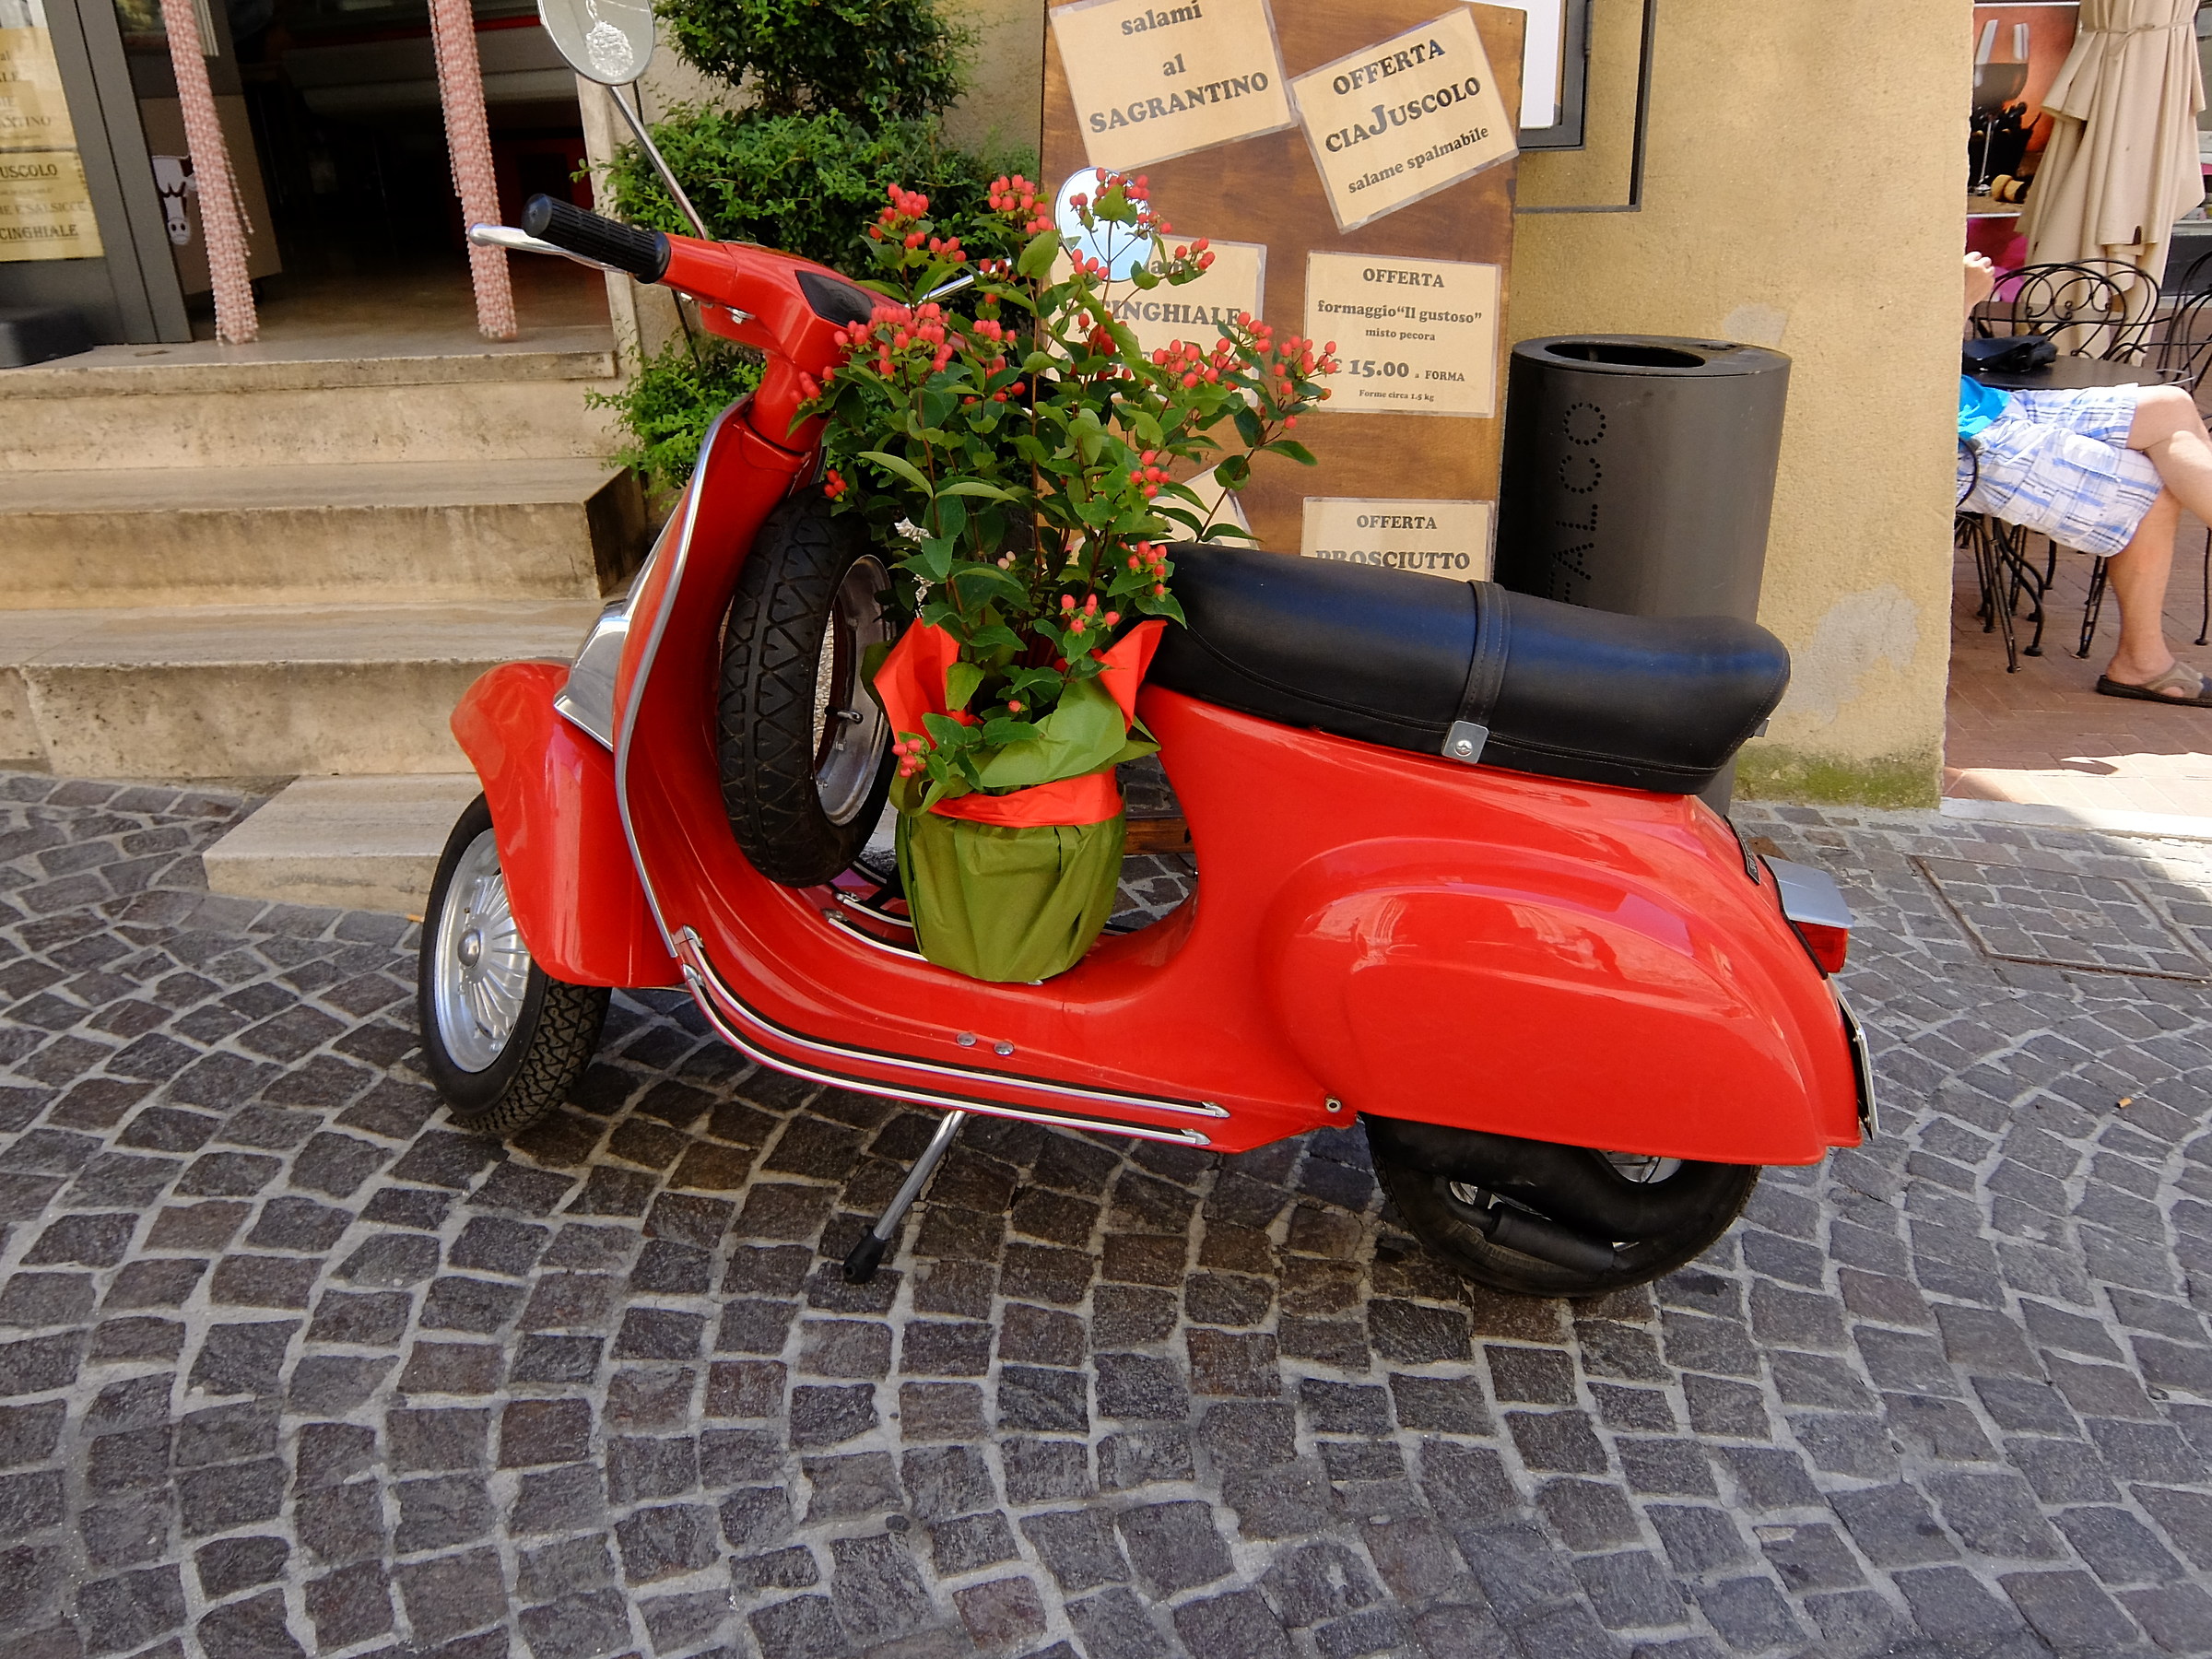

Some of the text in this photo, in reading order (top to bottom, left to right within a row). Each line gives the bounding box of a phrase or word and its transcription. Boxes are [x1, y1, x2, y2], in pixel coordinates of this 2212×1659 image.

[1121, 0, 1203, 35] salami
[1162, 53, 1187, 76] al
[1333, 39, 1445, 95] OFFERTA
[1089, 72, 1268, 133] SAGRANTINO
[1325, 76, 1481, 152] CIAJUSCOLO
[1348, 126, 1489, 194] salame spalmabile
[1362, 267, 1444, 288] OFFERTA
[1365, 328, 1436, 341] misto pecora
[1348, 359, 1409, 378] 15.00
[1425, 370, 1465, 382] FORMA
[1359, 389, 1386, 399] Forme
[1388, 391, 1409, 399] circa
[1424, 394, 1434, 403] kg
[1357, 514, 1437, 529] OFFERTA
